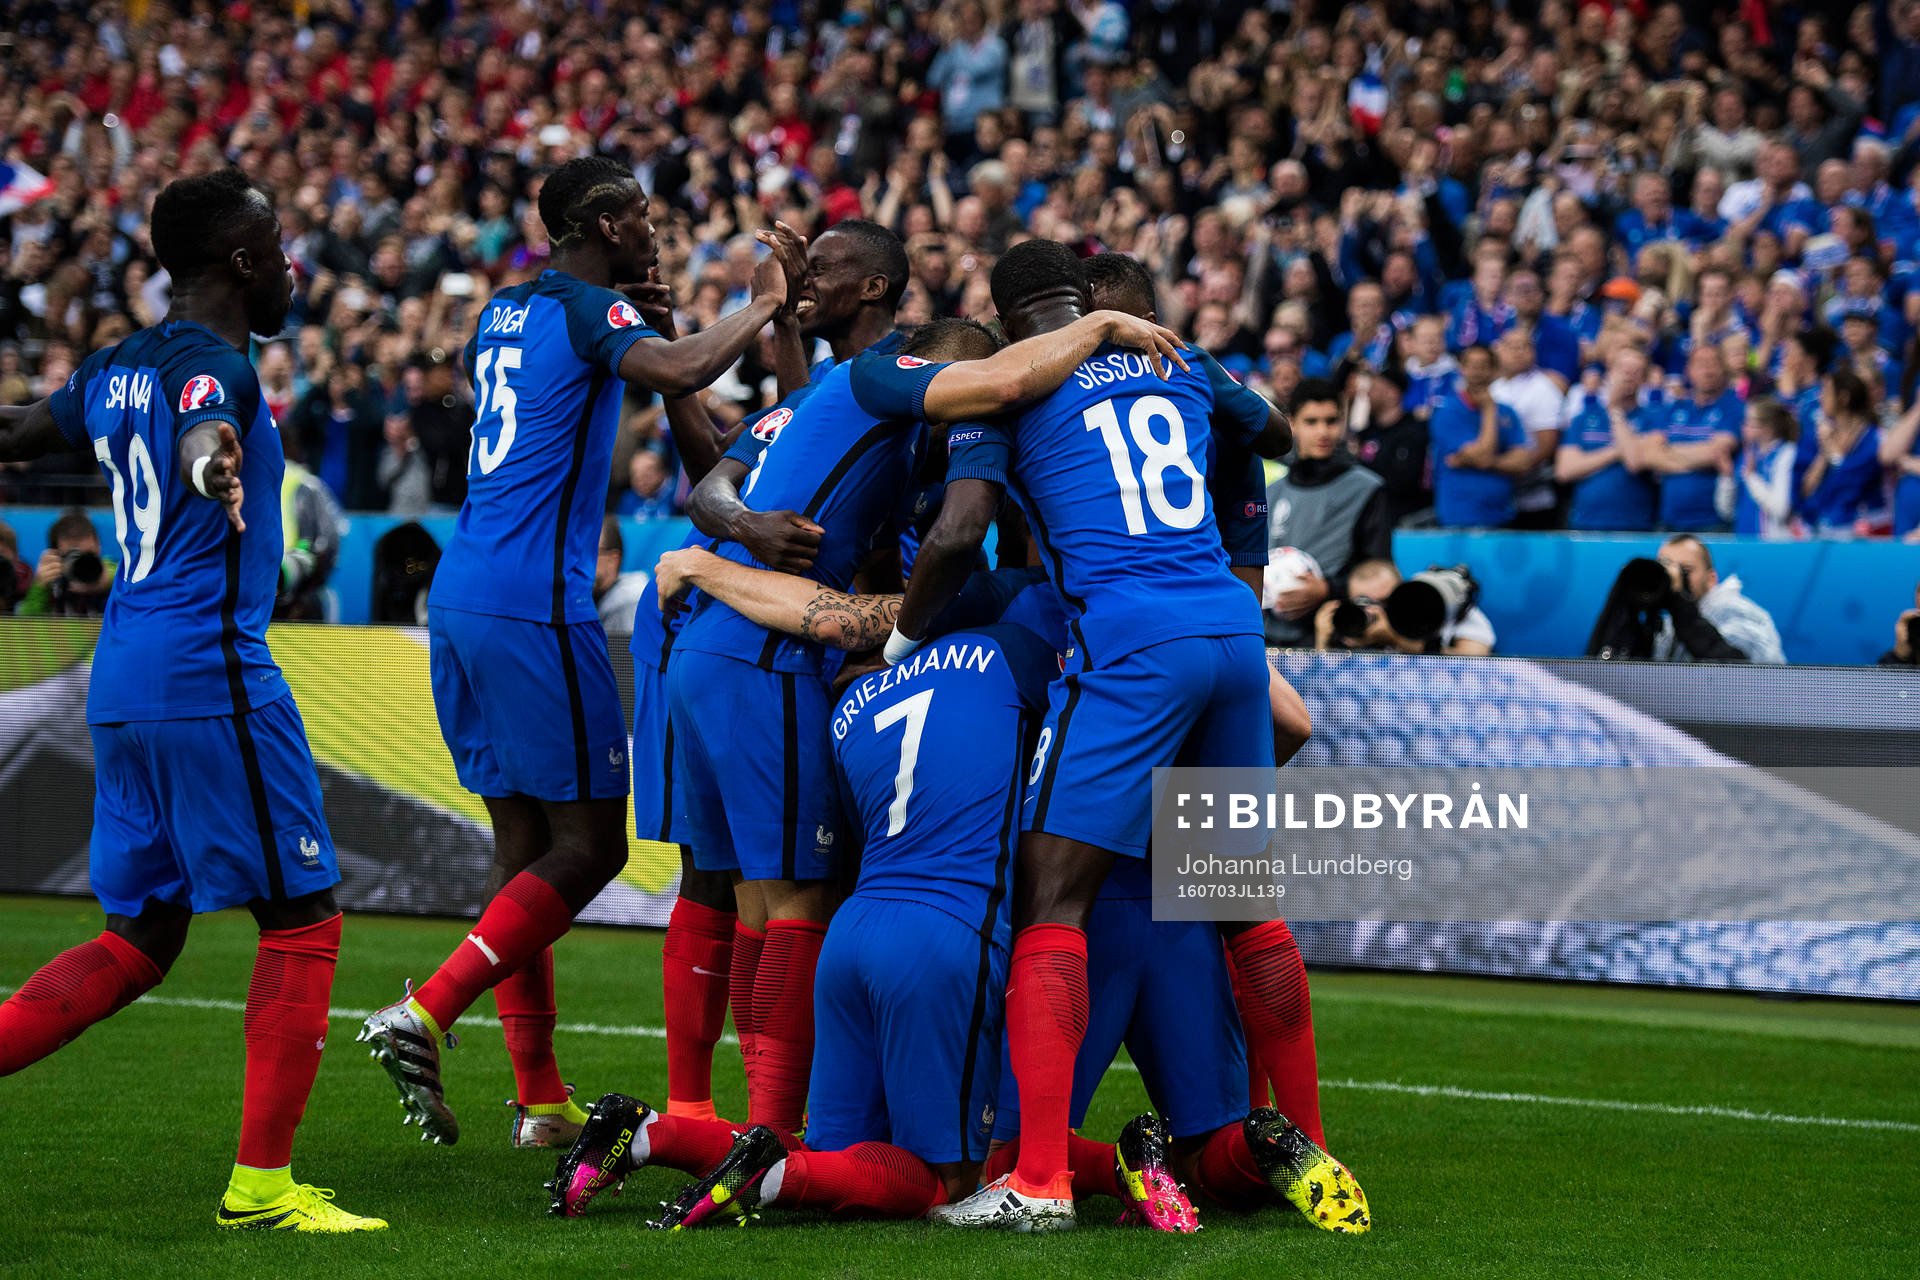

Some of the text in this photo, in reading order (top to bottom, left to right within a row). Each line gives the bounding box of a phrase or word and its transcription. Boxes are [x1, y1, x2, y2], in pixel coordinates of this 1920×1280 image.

[484, 305, 531, 333] POGA
[106, 373, 152, 413] SANA
[468, 346, 523, 475] 15
[951, 431, 983, 442] ESPECT
[94, 433, 161, 584] 19
[1083, 395, 1206, 536] 18
[833, 644, 996, 741] GRIEZMANN
[873, 688, 935, 837] 7
[1029, 727, 1052, 786] 8
